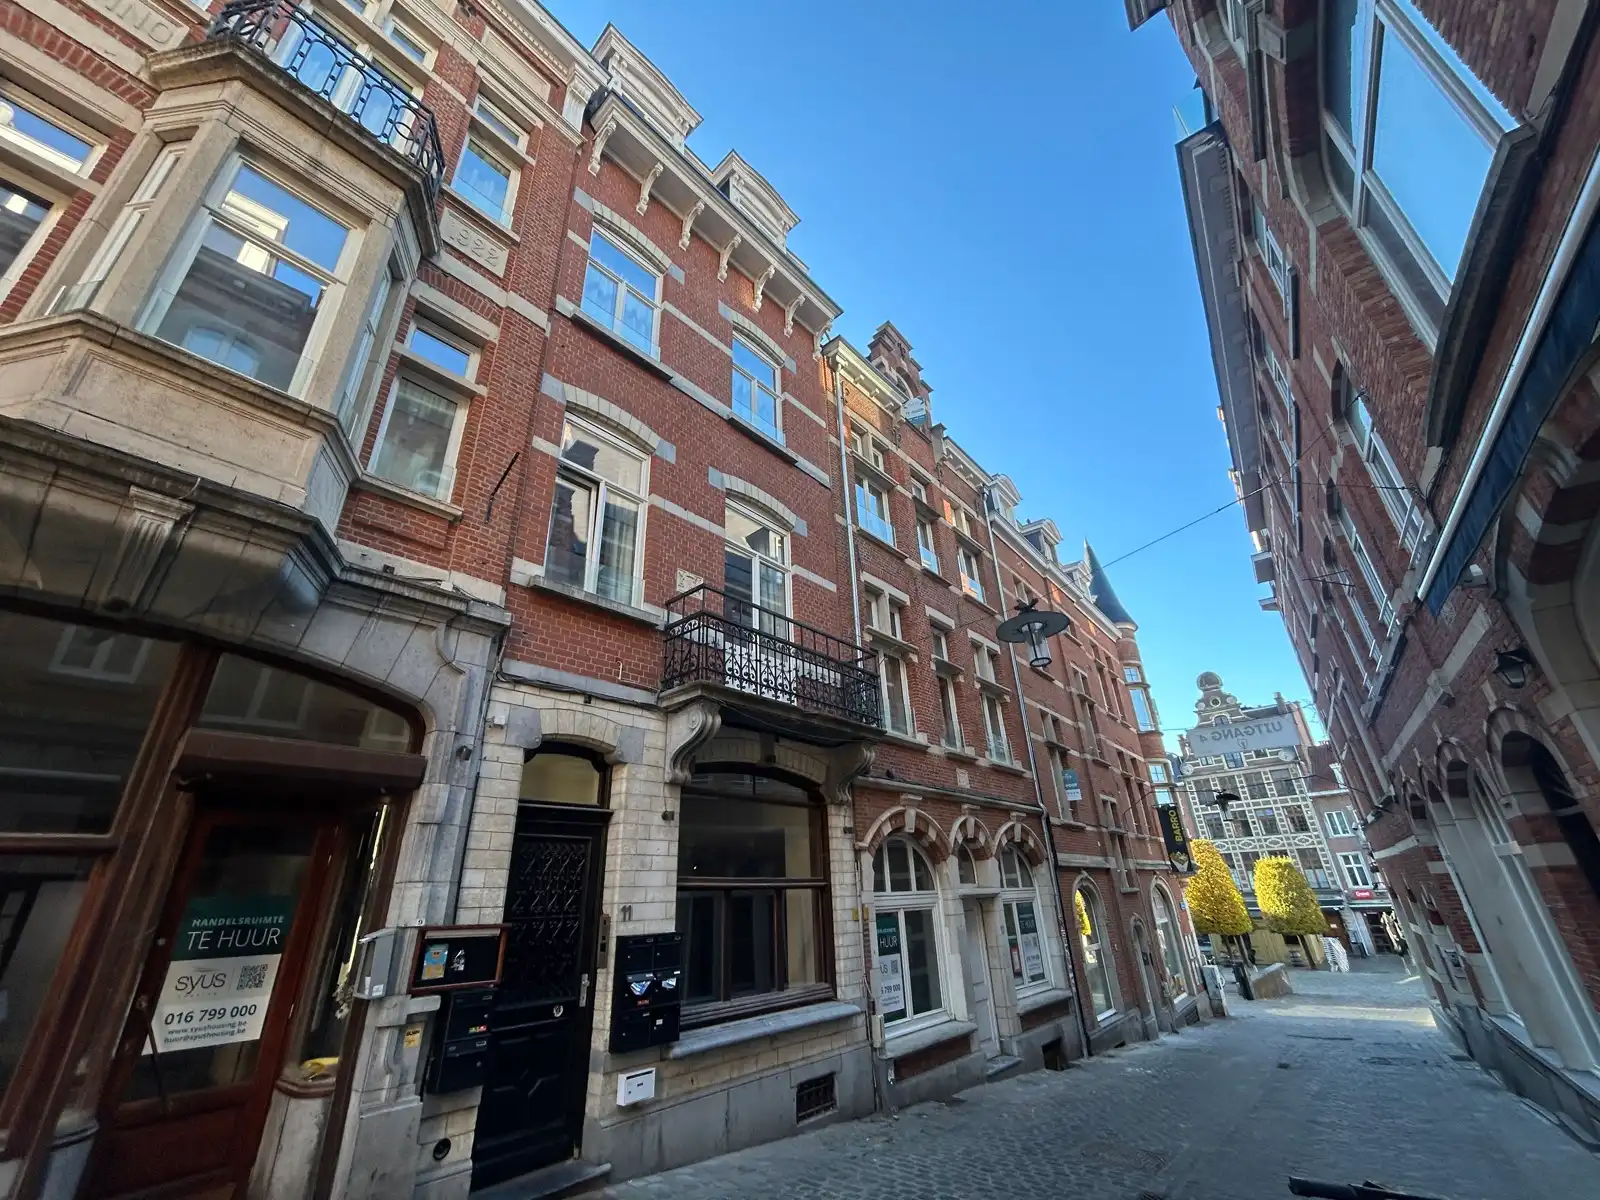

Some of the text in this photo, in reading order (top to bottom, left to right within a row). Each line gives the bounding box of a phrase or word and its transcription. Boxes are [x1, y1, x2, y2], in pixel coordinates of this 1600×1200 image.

[447, 222, 500, 268] 1922
[1168, 809, 1183, 842] BARRO
[191, 915, 285, 928] HANDELSRUIMTE
[620, 904, 632, 922] 11
[187, 927, 281, 951] TE HUUR
[880, 935, 898, 949] HUUR
[164, 1003, 258, 1025] 016 799 000
